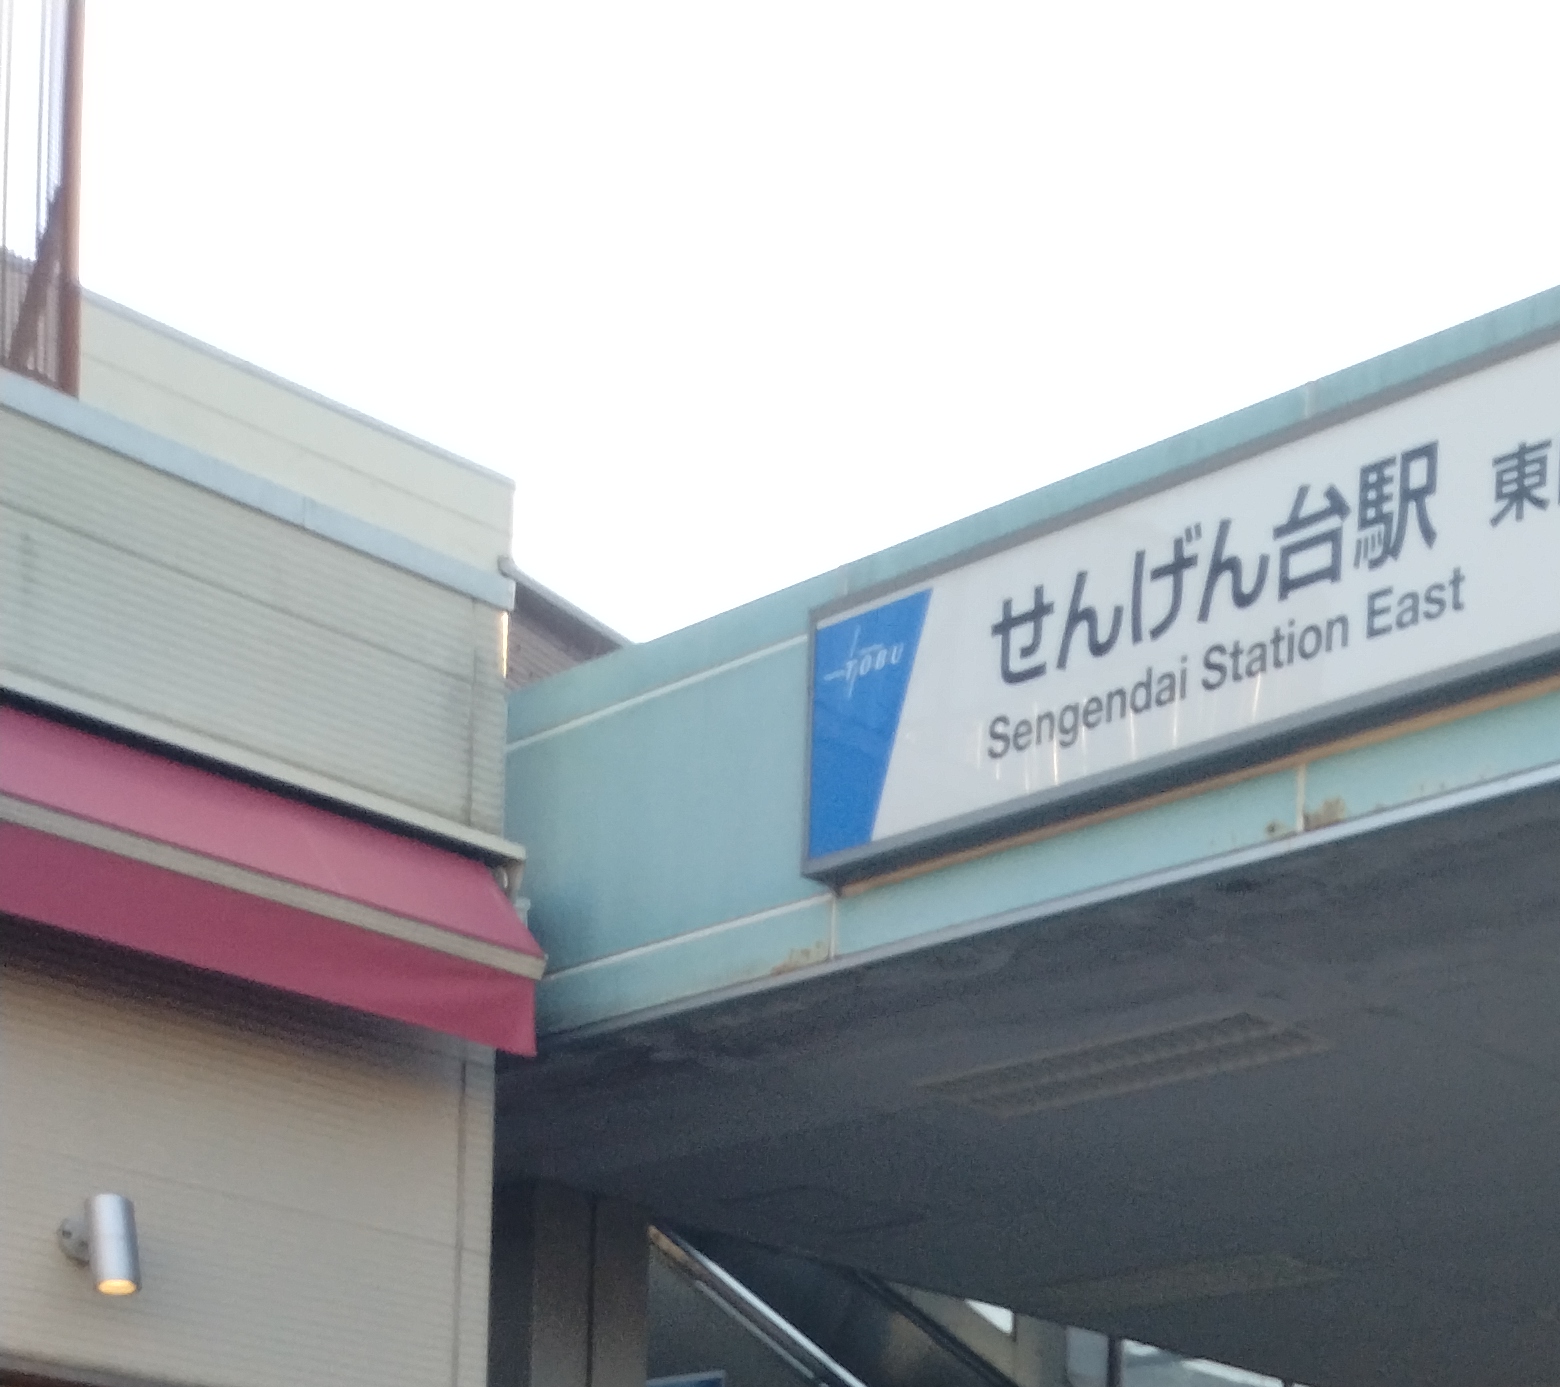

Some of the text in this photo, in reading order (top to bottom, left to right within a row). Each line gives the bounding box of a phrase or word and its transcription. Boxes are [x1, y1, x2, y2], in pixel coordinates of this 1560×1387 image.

[987, 566, 1466, 759] Sengendai Station East
[991, 438, 1438, 685] せんげん台駅
